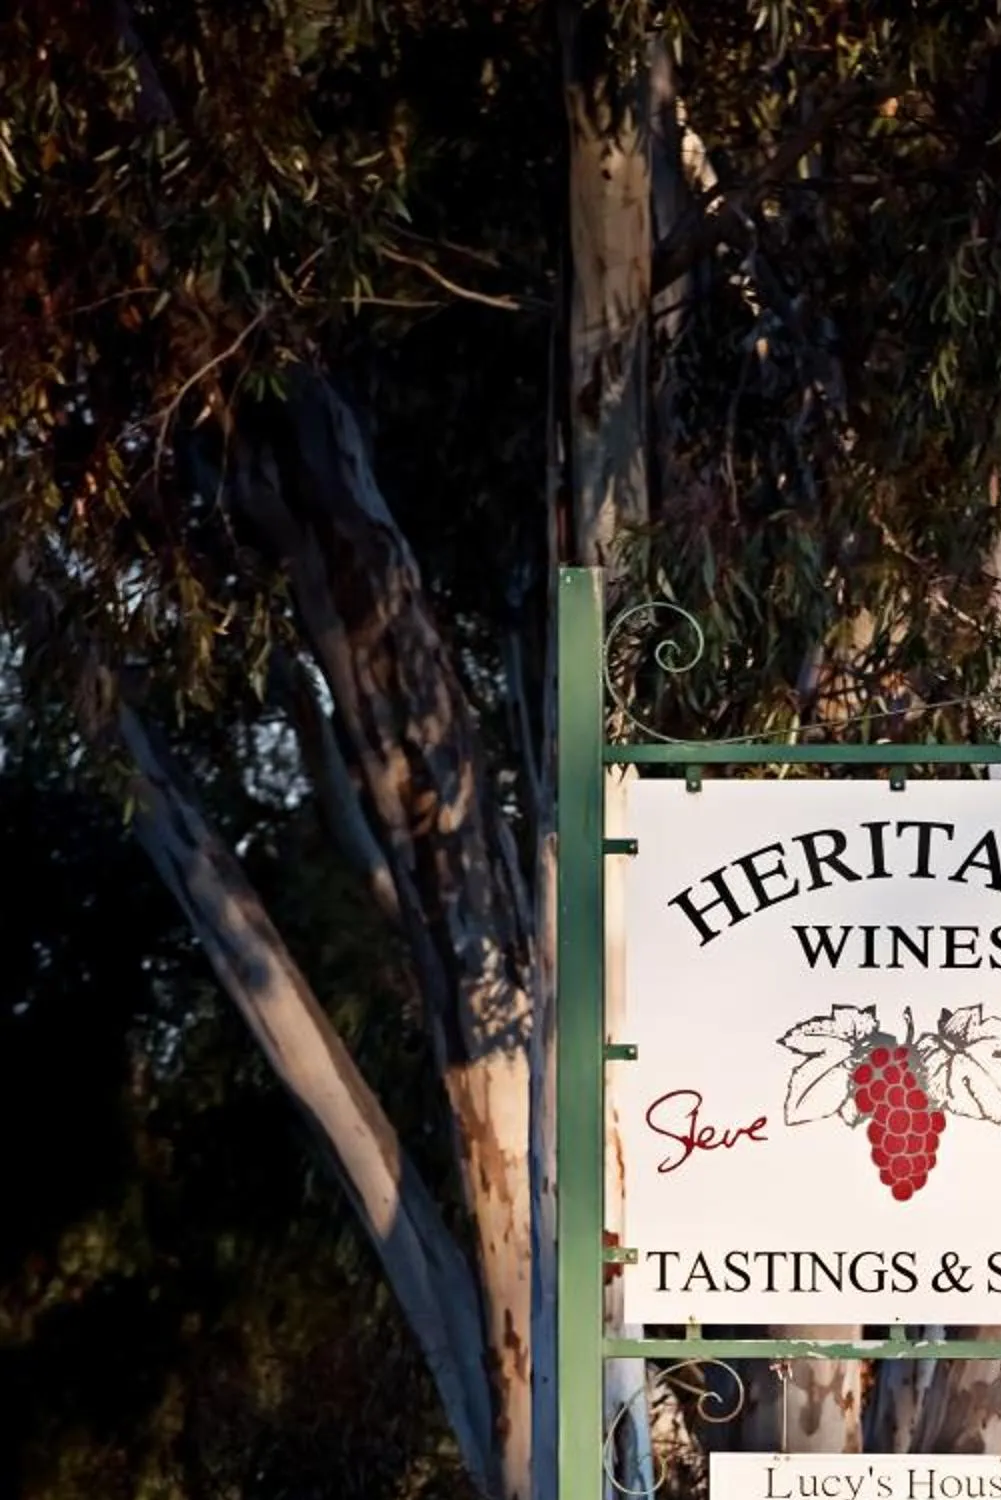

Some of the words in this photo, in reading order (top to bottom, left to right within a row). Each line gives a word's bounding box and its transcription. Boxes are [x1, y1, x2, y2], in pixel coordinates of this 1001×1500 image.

[645, 1089, 768, 1173] Steve
[646, 1250, 917, 1293] TASTINGS
[931, 1252, 973, 1293] &
